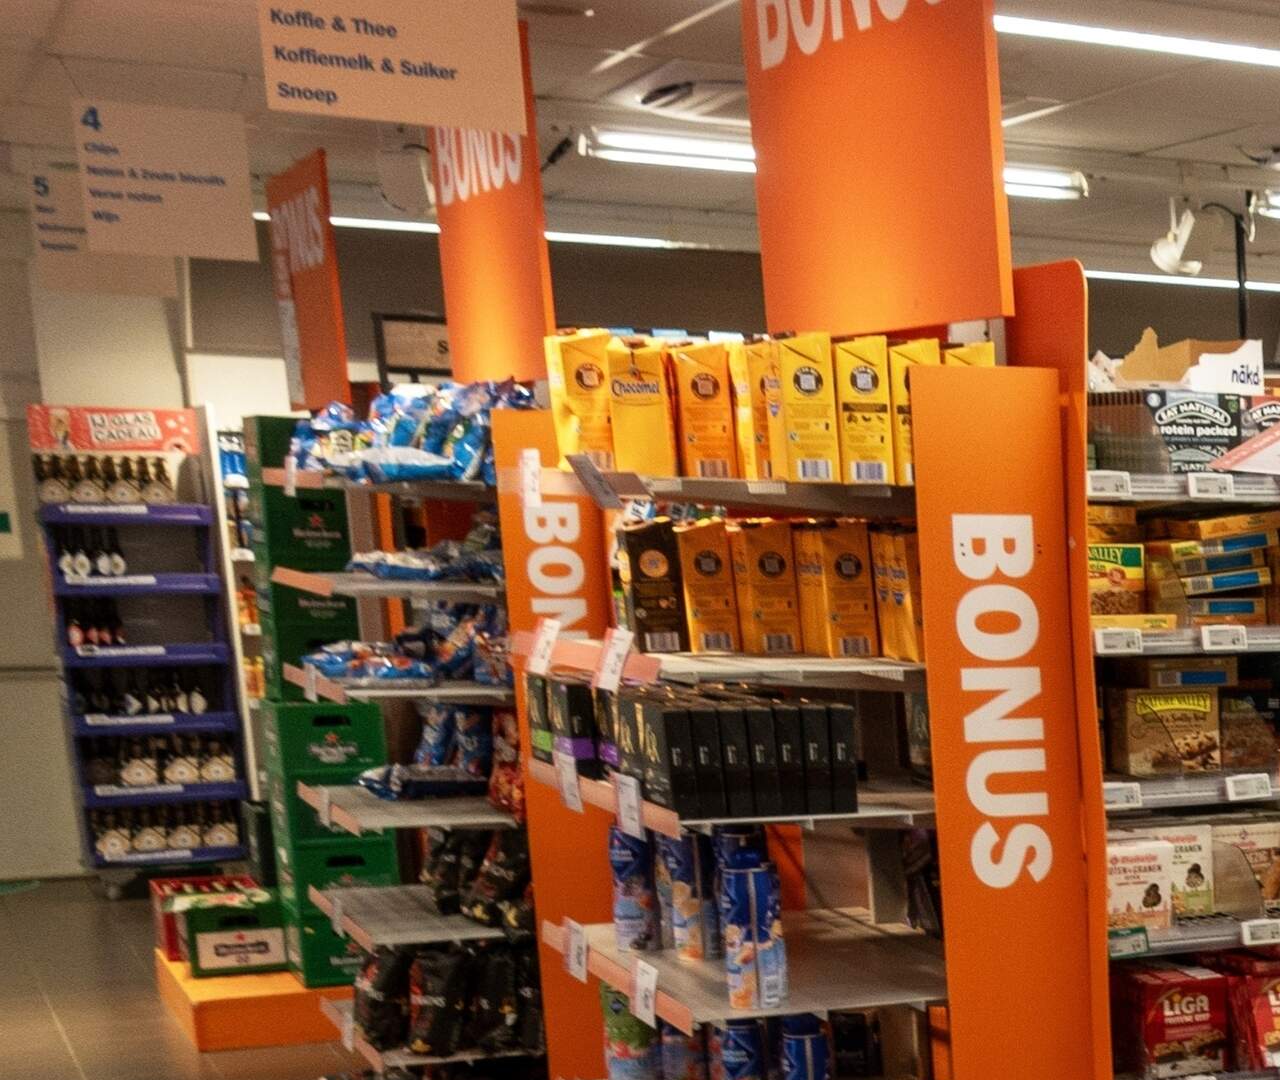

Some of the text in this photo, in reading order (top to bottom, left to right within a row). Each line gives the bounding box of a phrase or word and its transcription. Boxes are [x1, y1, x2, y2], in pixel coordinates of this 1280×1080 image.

[270, 8, 398, 38] Koffie & Thee
[274, 45, 458, 80] Koffiemelk & Suiker
[277, 82, 338, 105] Snoep
[81, 107, 102, 131] 4
[33, 175, 49, 197] 5
[1196, 423, 1238, 438] packed
[951, 512, 1053, 889] BONUS
